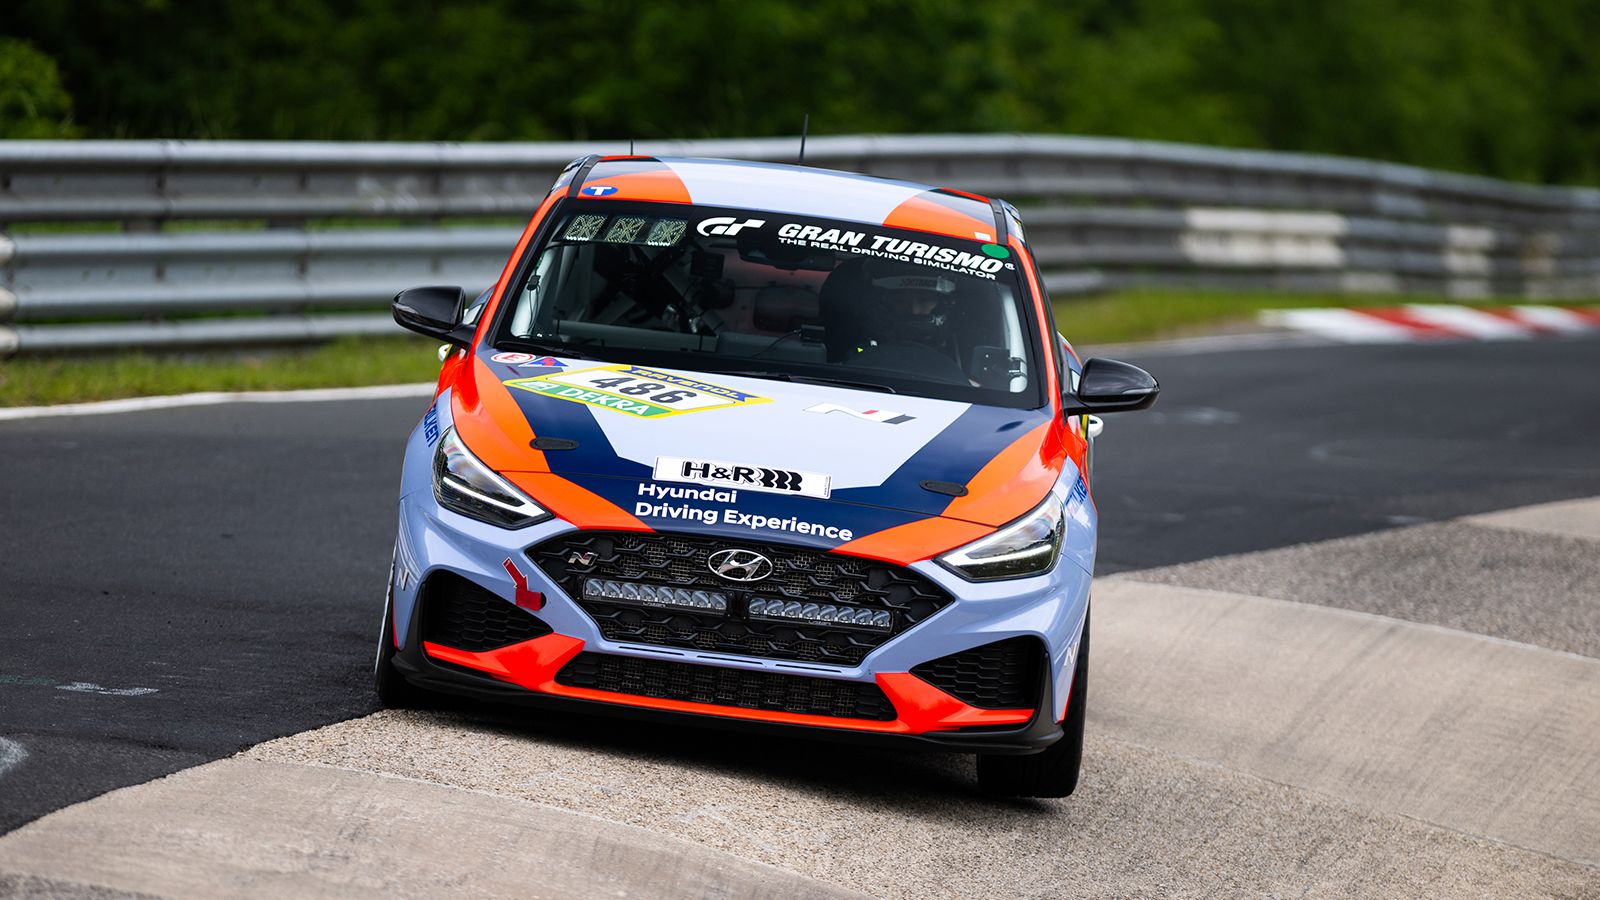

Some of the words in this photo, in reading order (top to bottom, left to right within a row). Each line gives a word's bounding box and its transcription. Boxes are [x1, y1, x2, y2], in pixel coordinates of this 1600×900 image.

[590, 187, 612, 195] T
[697, 217, 766, 237] GT
[777, 223, 866, 246] GRAN
[778, 237, 808, 247] THE
[811, 241, 848, 252] REAL
[851, 247, 910, 262] DRIVING
[913, 258, 997, 281] SIMULATOR
[589, 377, 697, 403] 486
[633, 369, 740, 398] RAVENOL
[557, 388, 650, 415] DEKRA
[637, 483, 738, 504] Hyundai
[634, 502, 719, 525] Driving
[724, 509, 853, 541] Experience
